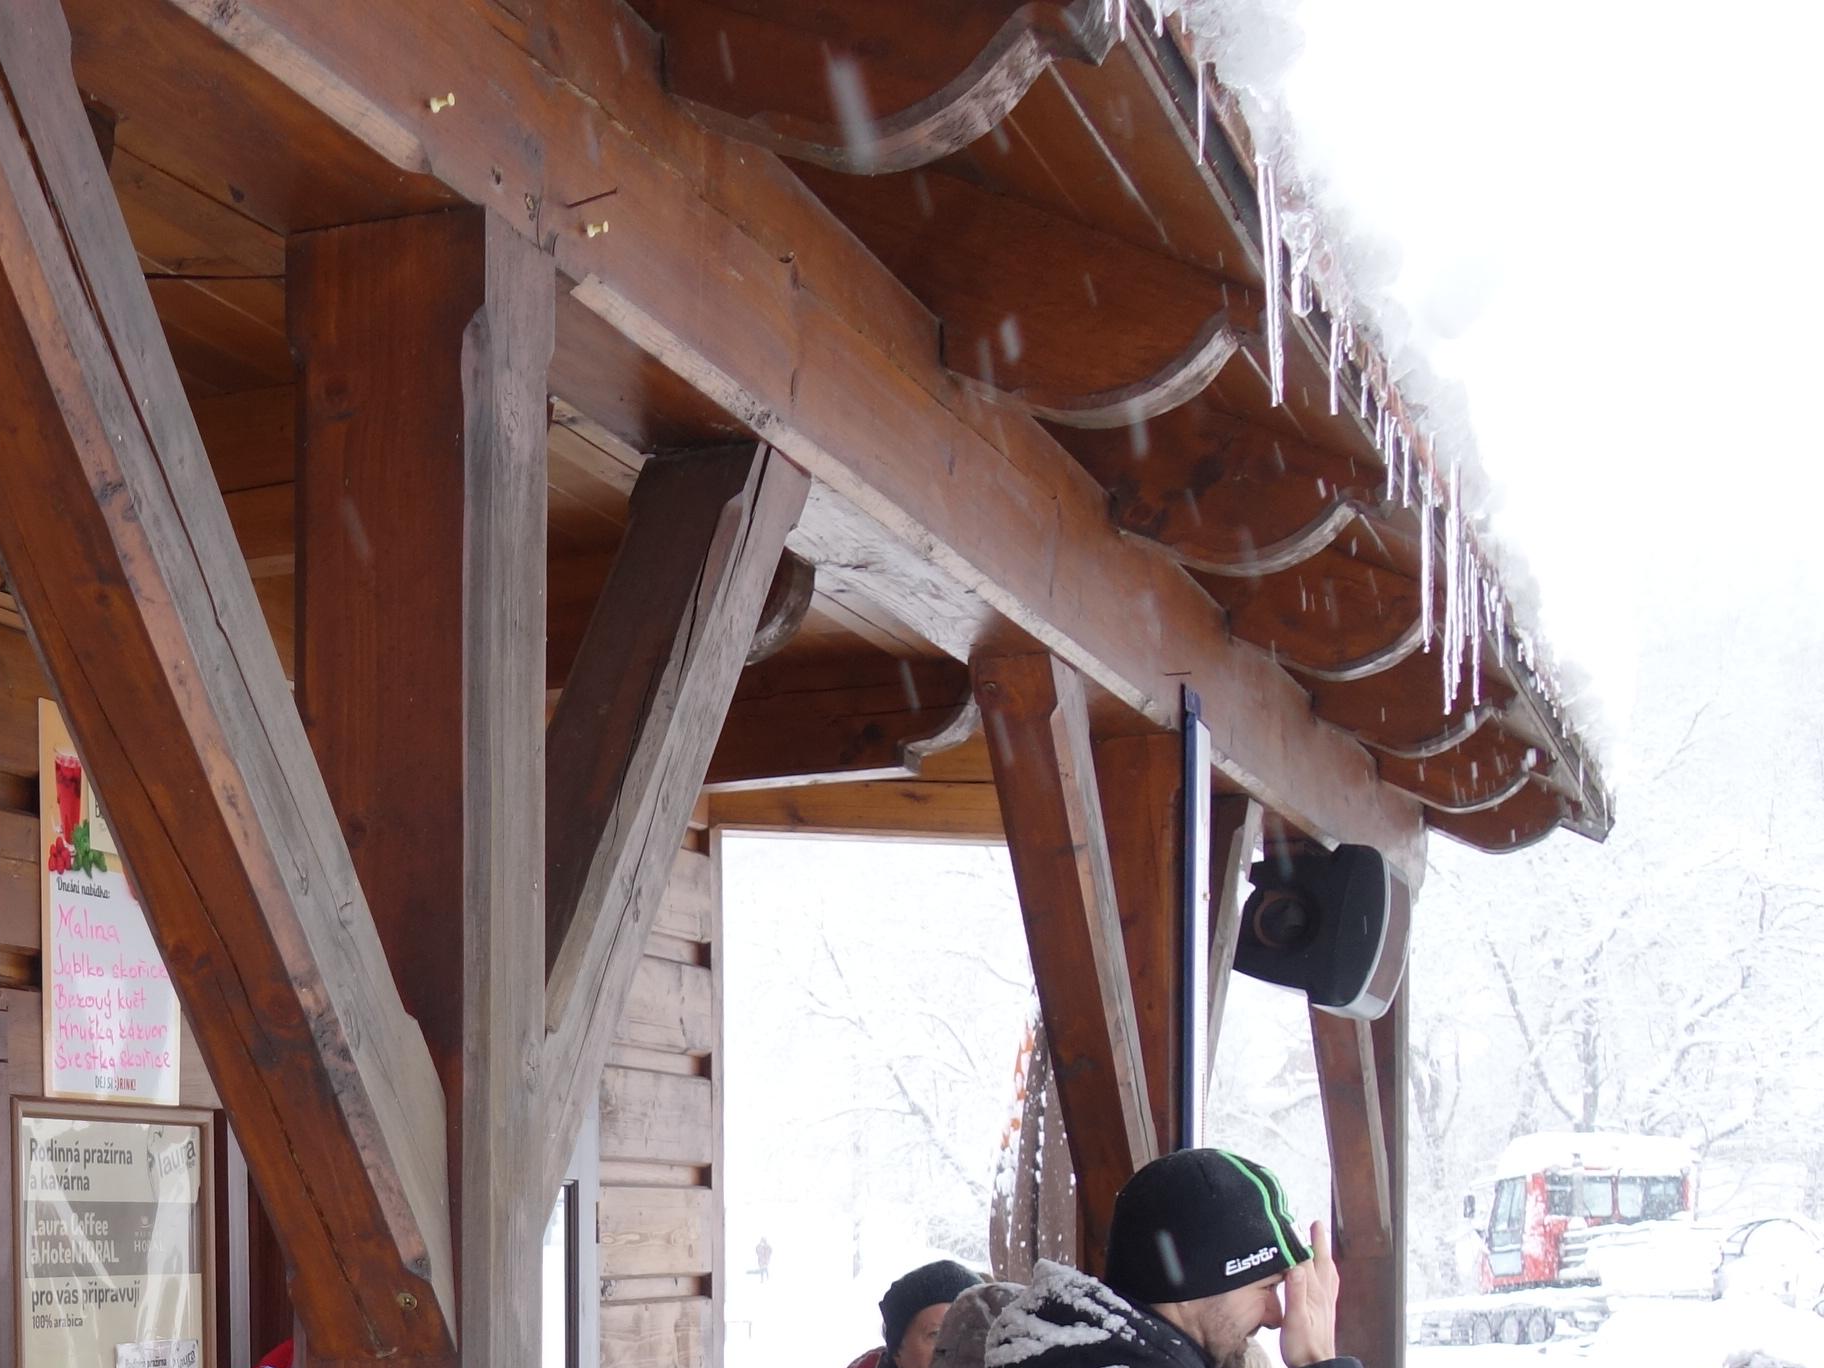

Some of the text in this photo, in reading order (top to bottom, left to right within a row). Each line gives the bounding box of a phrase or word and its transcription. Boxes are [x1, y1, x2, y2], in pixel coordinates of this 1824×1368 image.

[30, 1138, 133, 1169] Rodinná pražírna
[40, 1169, 90, 1191] kavárna
[1224, 1246, 1278, 1277] Eisbär
[32, 1289, 53, 1312] pro
[56, 1282, 79, 1304] vás
